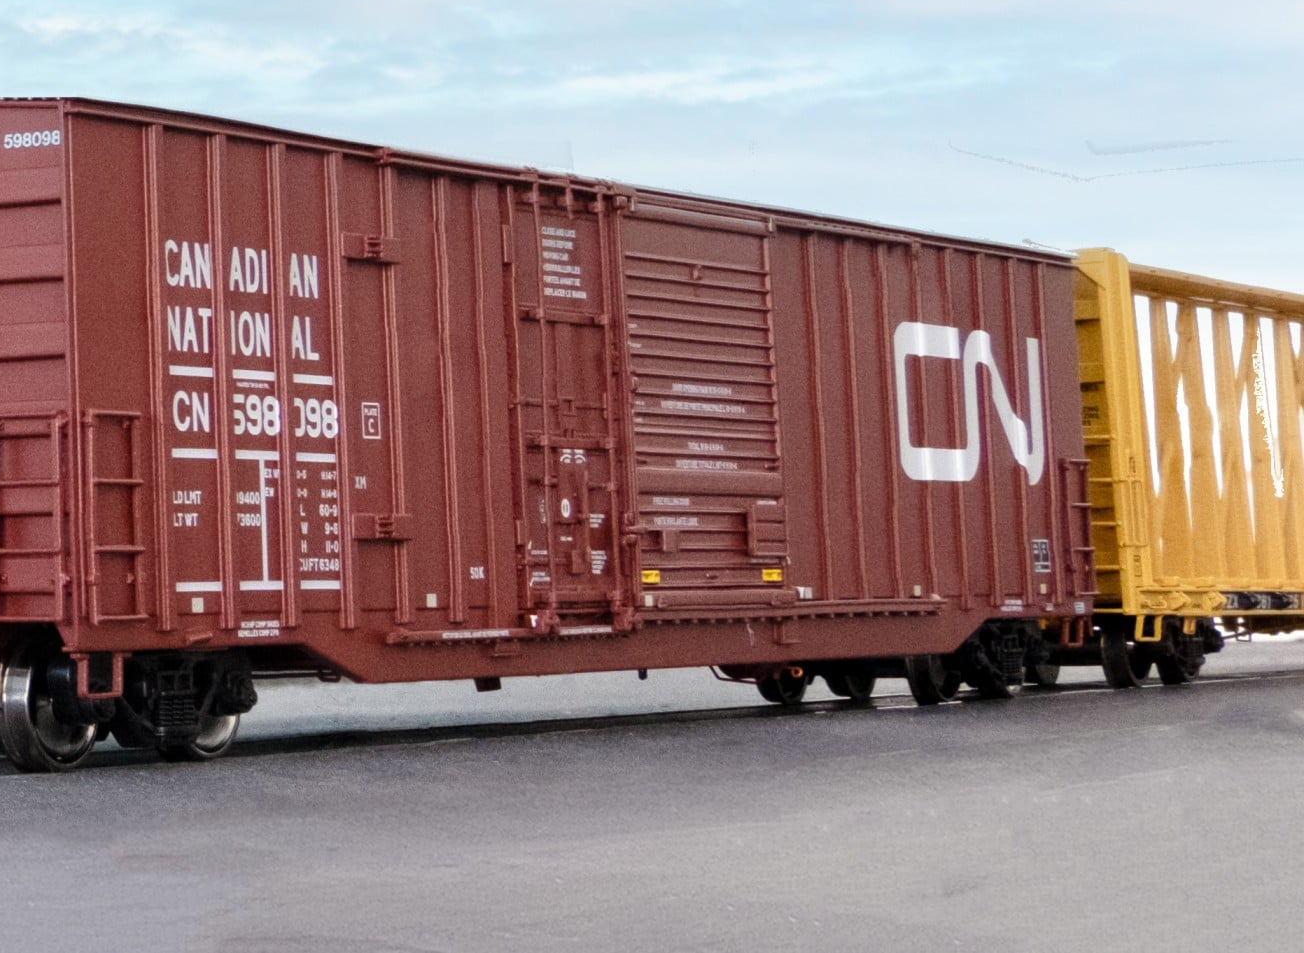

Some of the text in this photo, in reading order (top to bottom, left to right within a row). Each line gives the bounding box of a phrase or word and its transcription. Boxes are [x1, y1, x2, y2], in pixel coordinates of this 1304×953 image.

[3, 130, 61, 149] 598098
[894, 321, 1044, 485] CN
[172, 390, 210, 433] CN
[368, 418, 375, 433] C
[355, 476, 367, 489] XM
[184, 491, 202, 505] LMT
[300, 504, 306, 516] L
[184, 513, 198, 527] WT
[301, 522, 308, 535] W
[301, 540, 307, 553] H
